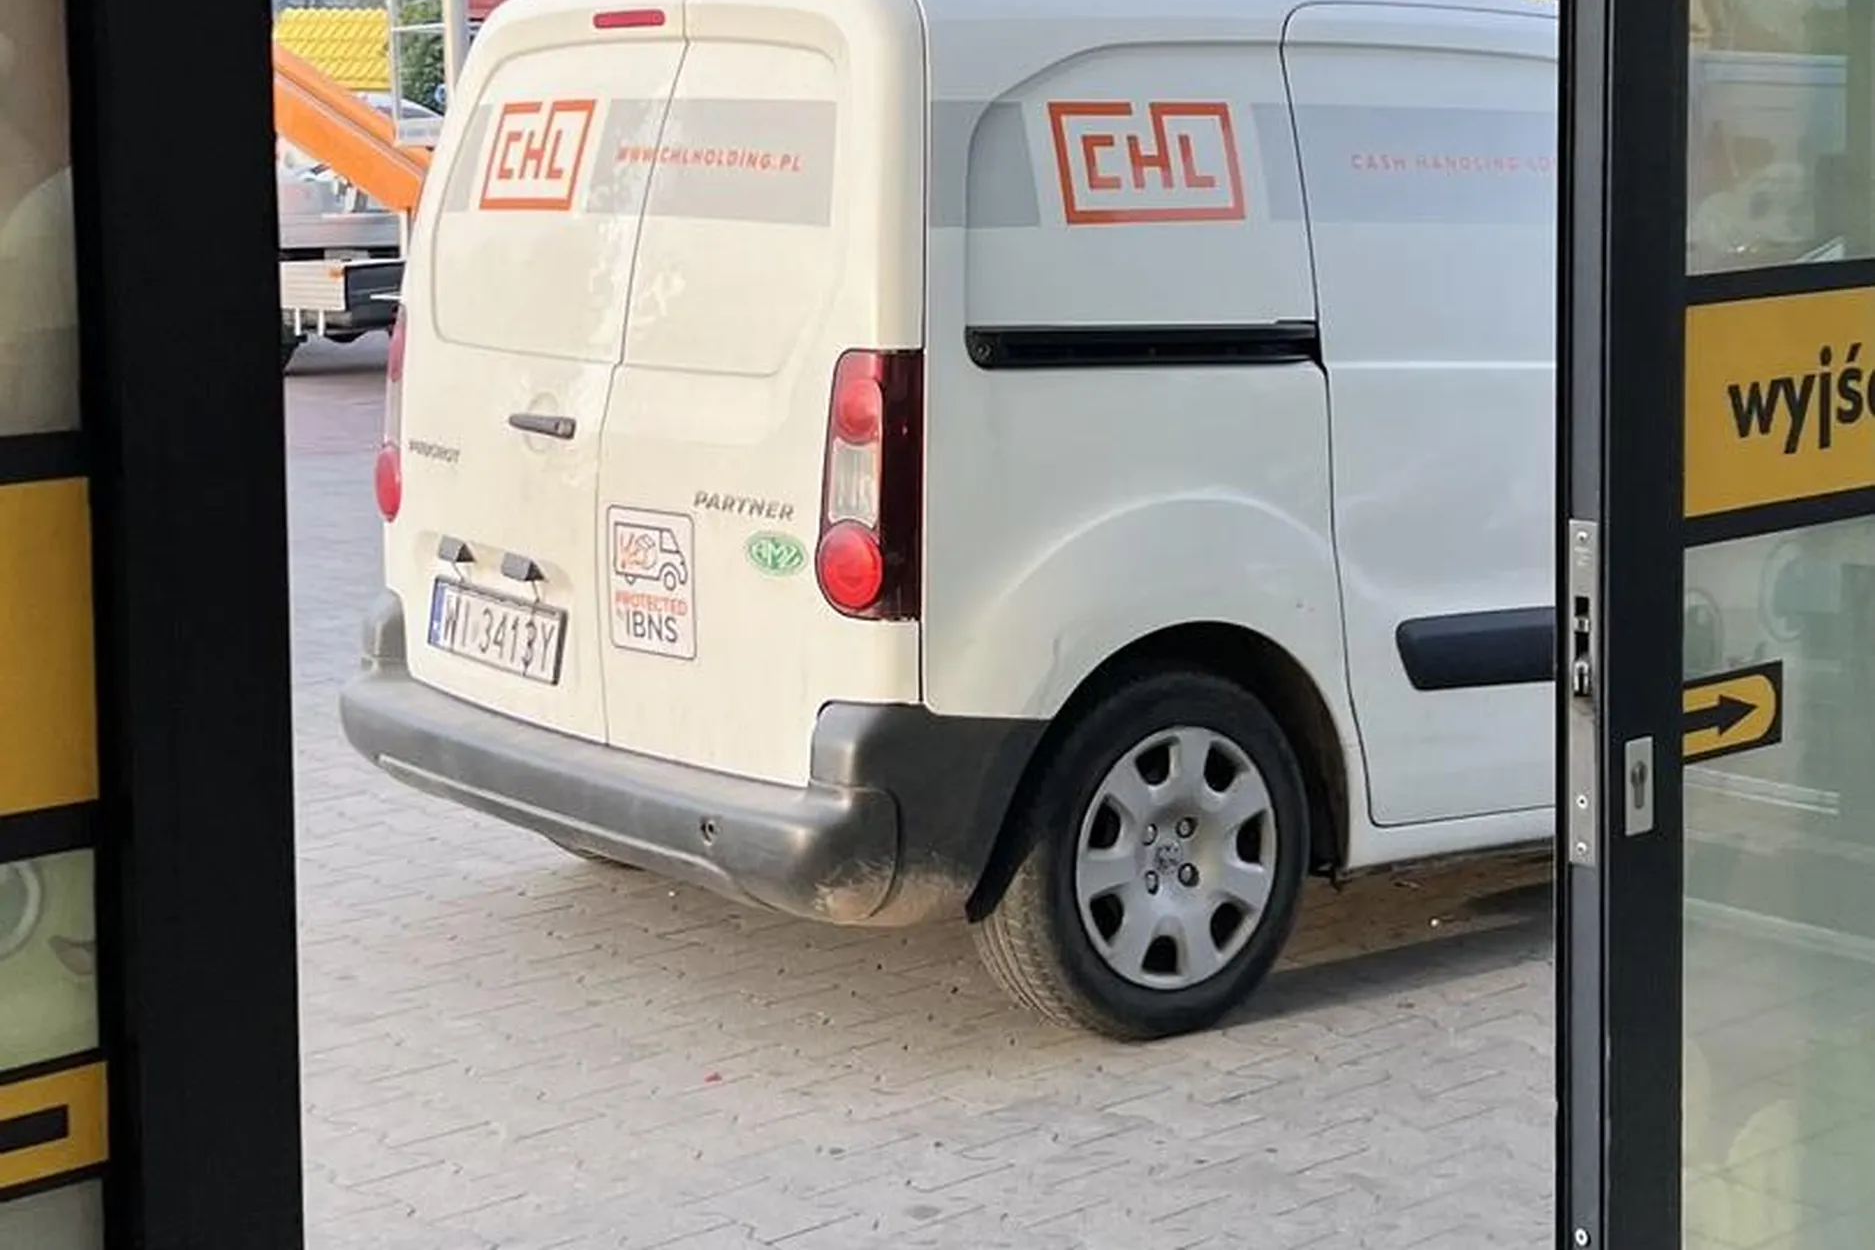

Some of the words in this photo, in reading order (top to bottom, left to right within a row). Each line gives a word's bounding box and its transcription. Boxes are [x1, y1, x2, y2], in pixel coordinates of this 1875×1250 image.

[1350, 153, 1406, 171] CASH
[1415, 155, 1521, 172] HANDLING
[1728, 342, 1875, 454] wyjś
[692, 490, 797, 522] PARTNER
[614, 589, 688, 617] PROTECTED
[626, 609, 678, 643] IBNS
